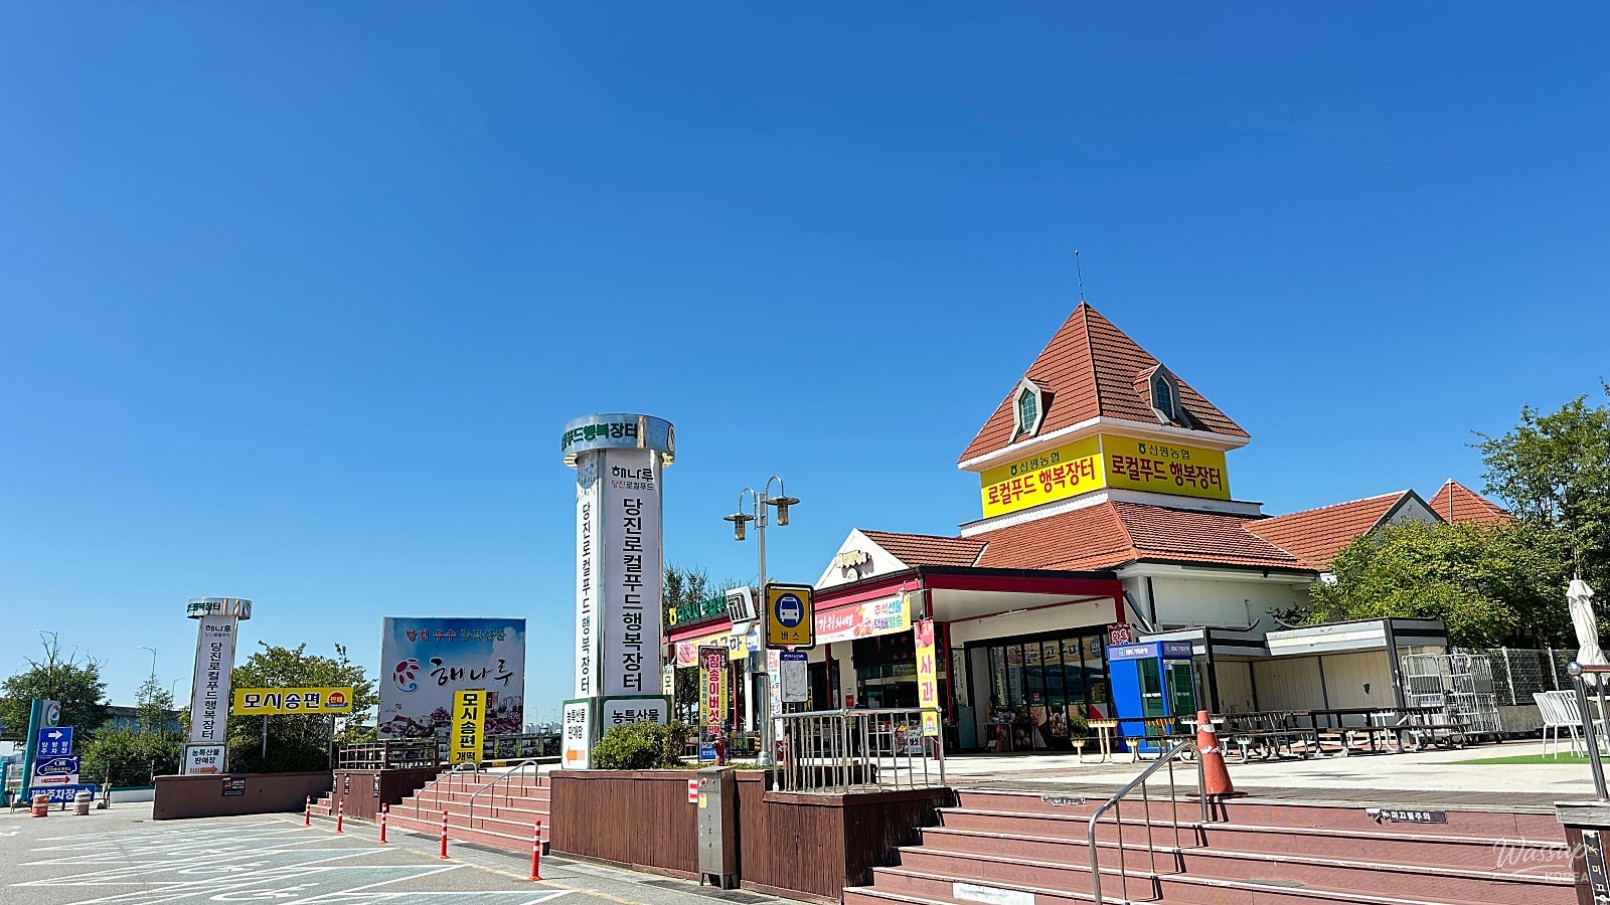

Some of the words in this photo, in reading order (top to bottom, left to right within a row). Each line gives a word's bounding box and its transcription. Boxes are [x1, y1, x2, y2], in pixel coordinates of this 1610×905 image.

[1020, 451, 1061, 473] 신평농협
[1149, 444, 1191, 460] 신평농협
[611, 465, 654, 482] 해나루
[988, 474, 1037, 505] 로컬푸드
[1038, 457, 1095, 493] 행복장터
[1111, 454, 1168, 482] 로컬푸드
[1168, 461, 1223, 491] 행복장터
[622, 498, 643, 692] 당진로컬푸드행복장터
[430, 658, 514, 686] 해나루
[920, 654, 934, 702] 사과
[201, 641, 223, 740] 당진로컬푸드행복장터
[243, 692, 320, 710] 모시송편
[709, 655, 719, 723] 참송이버섯
[459, 693, 478, 749] 모시송편
[611, 708, 660, 724] 농특산물
[456, 751, 476, 761] 개떡
